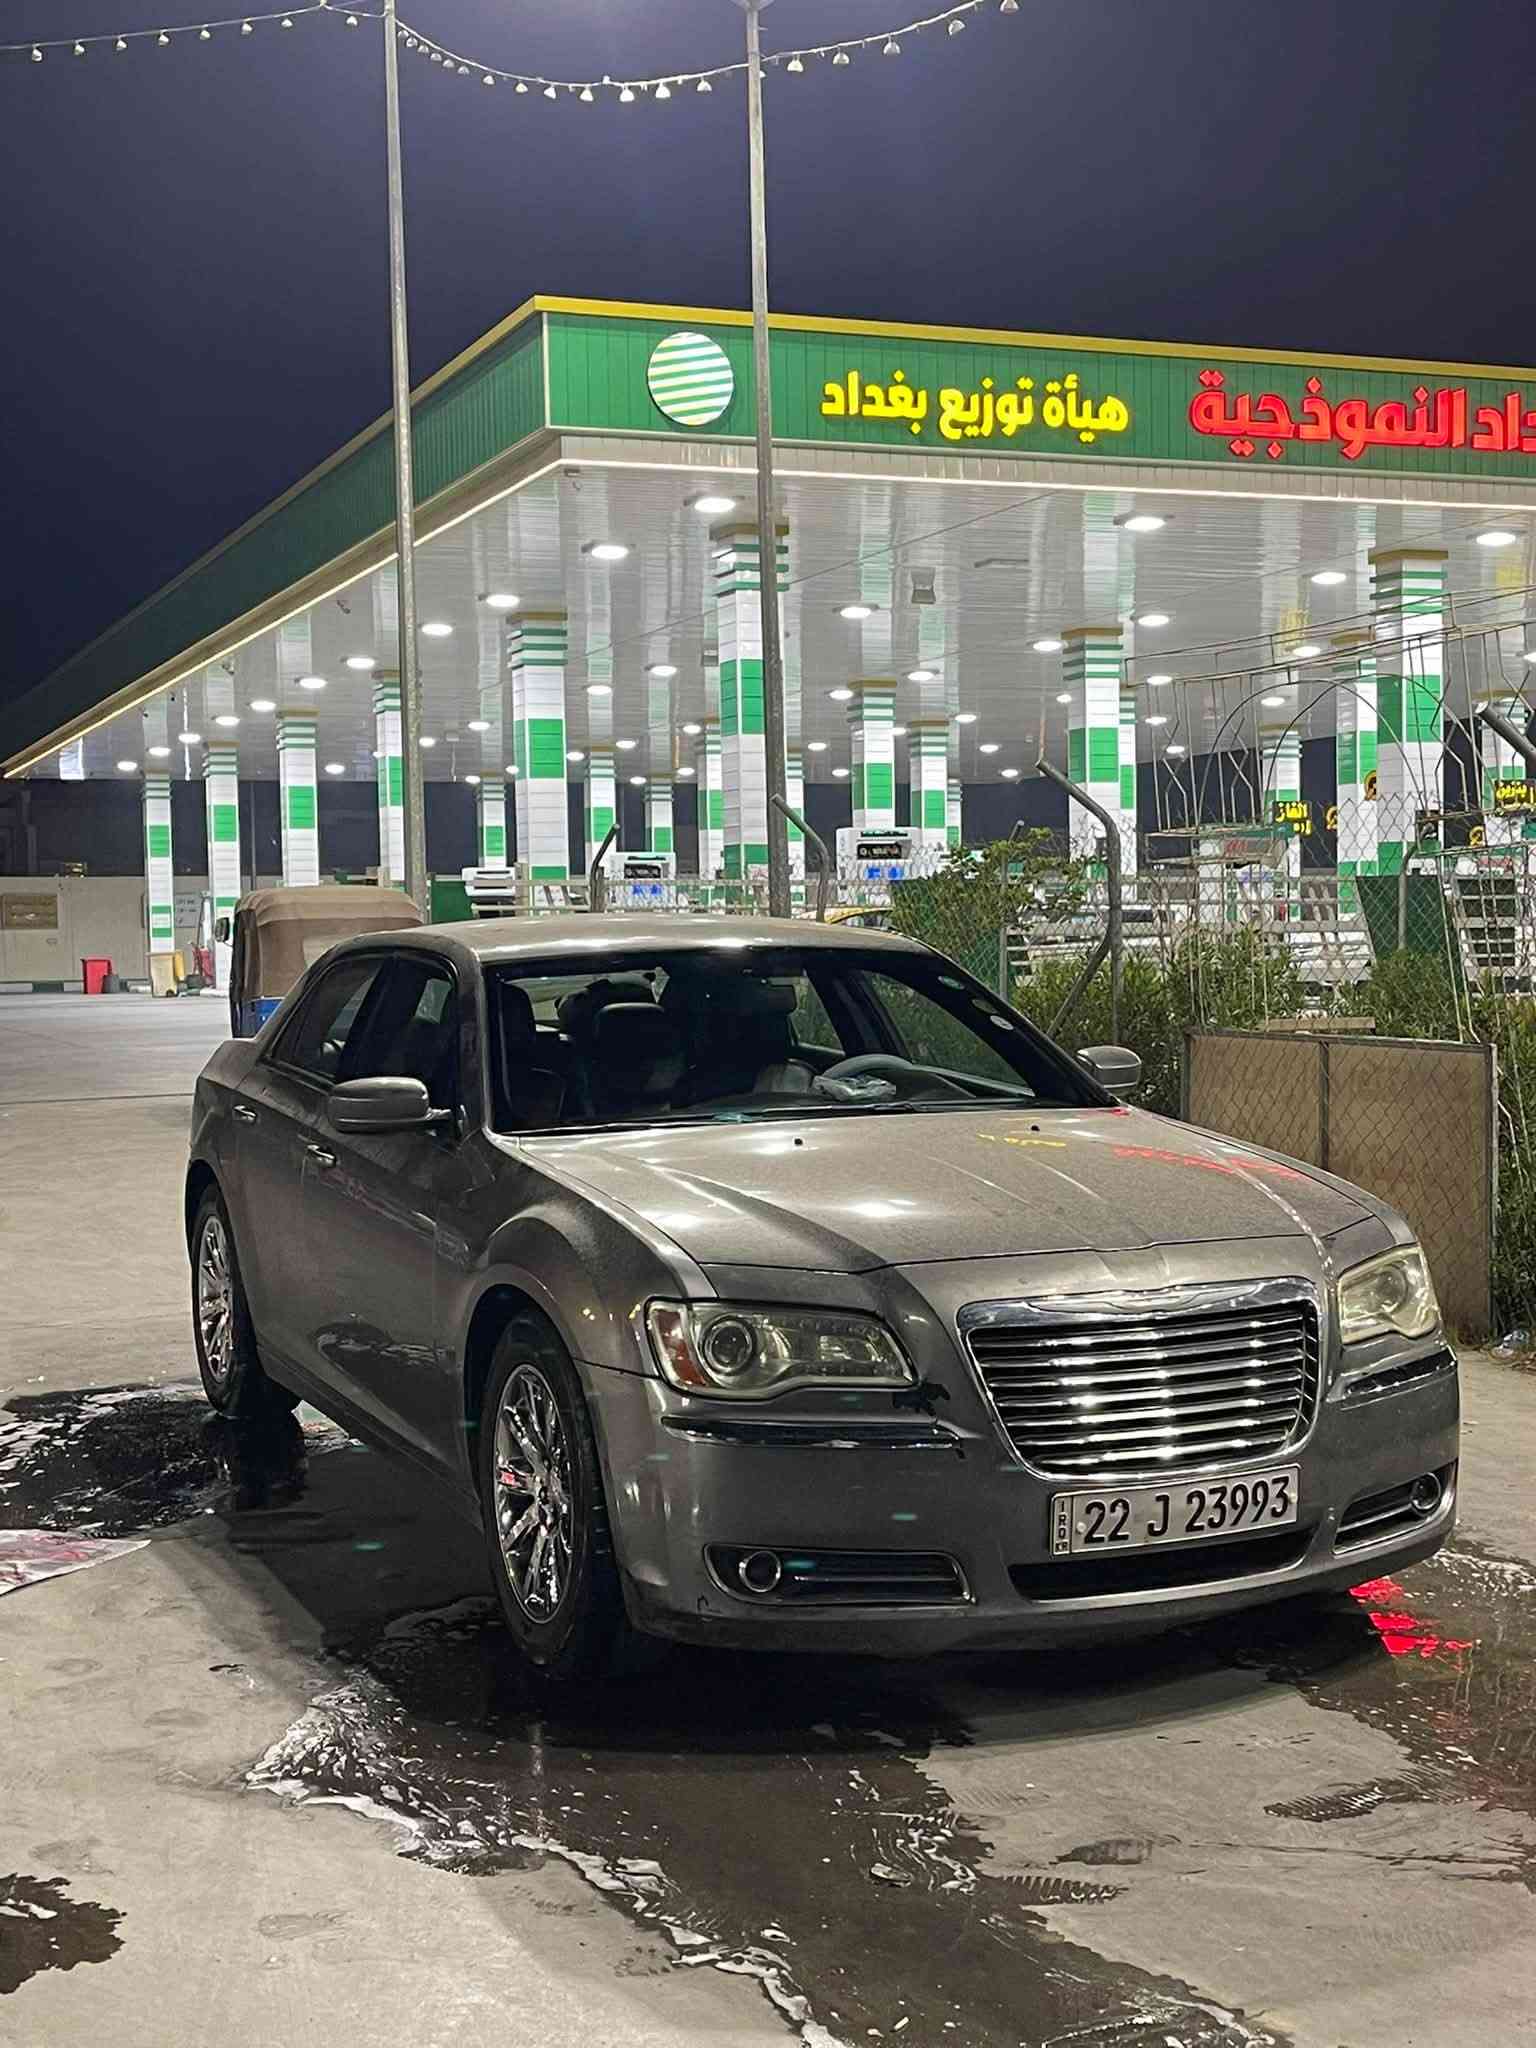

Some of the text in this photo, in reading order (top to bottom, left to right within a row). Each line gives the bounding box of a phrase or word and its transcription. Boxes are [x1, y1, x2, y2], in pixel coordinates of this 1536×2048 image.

[821, 370, 1129, 443] هيأة توزيع بغداد
[1191, 370, 1466, 461] النموذجية
[1084, 1475, 1290, 1544] 22 J 23993
